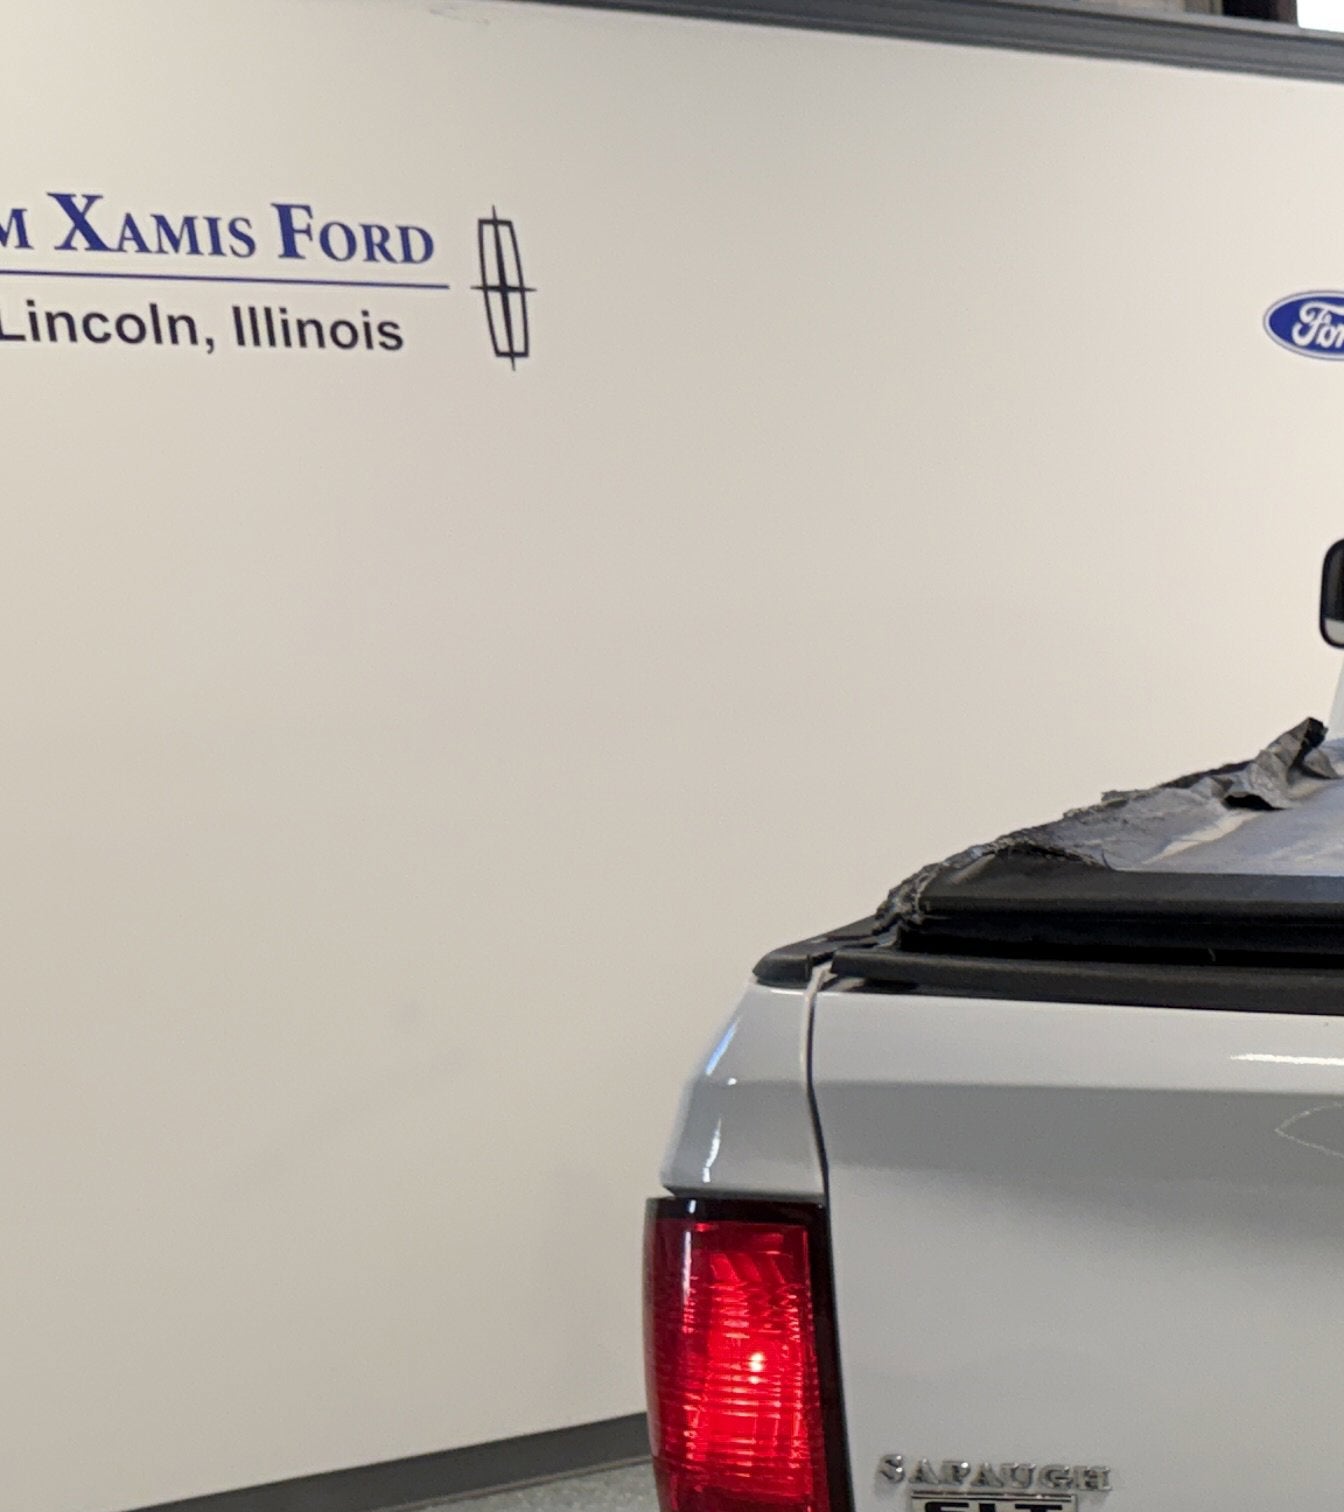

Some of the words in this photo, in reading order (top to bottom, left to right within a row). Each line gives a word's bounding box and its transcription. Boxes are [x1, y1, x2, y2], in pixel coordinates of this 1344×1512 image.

[46, 191, 257, 259] XAMIS
[271, 202, 436, 265] FORD
[233, 305, 404, 351] Illinois
[875, 1453, 1113, 1492] SAPAUGH
